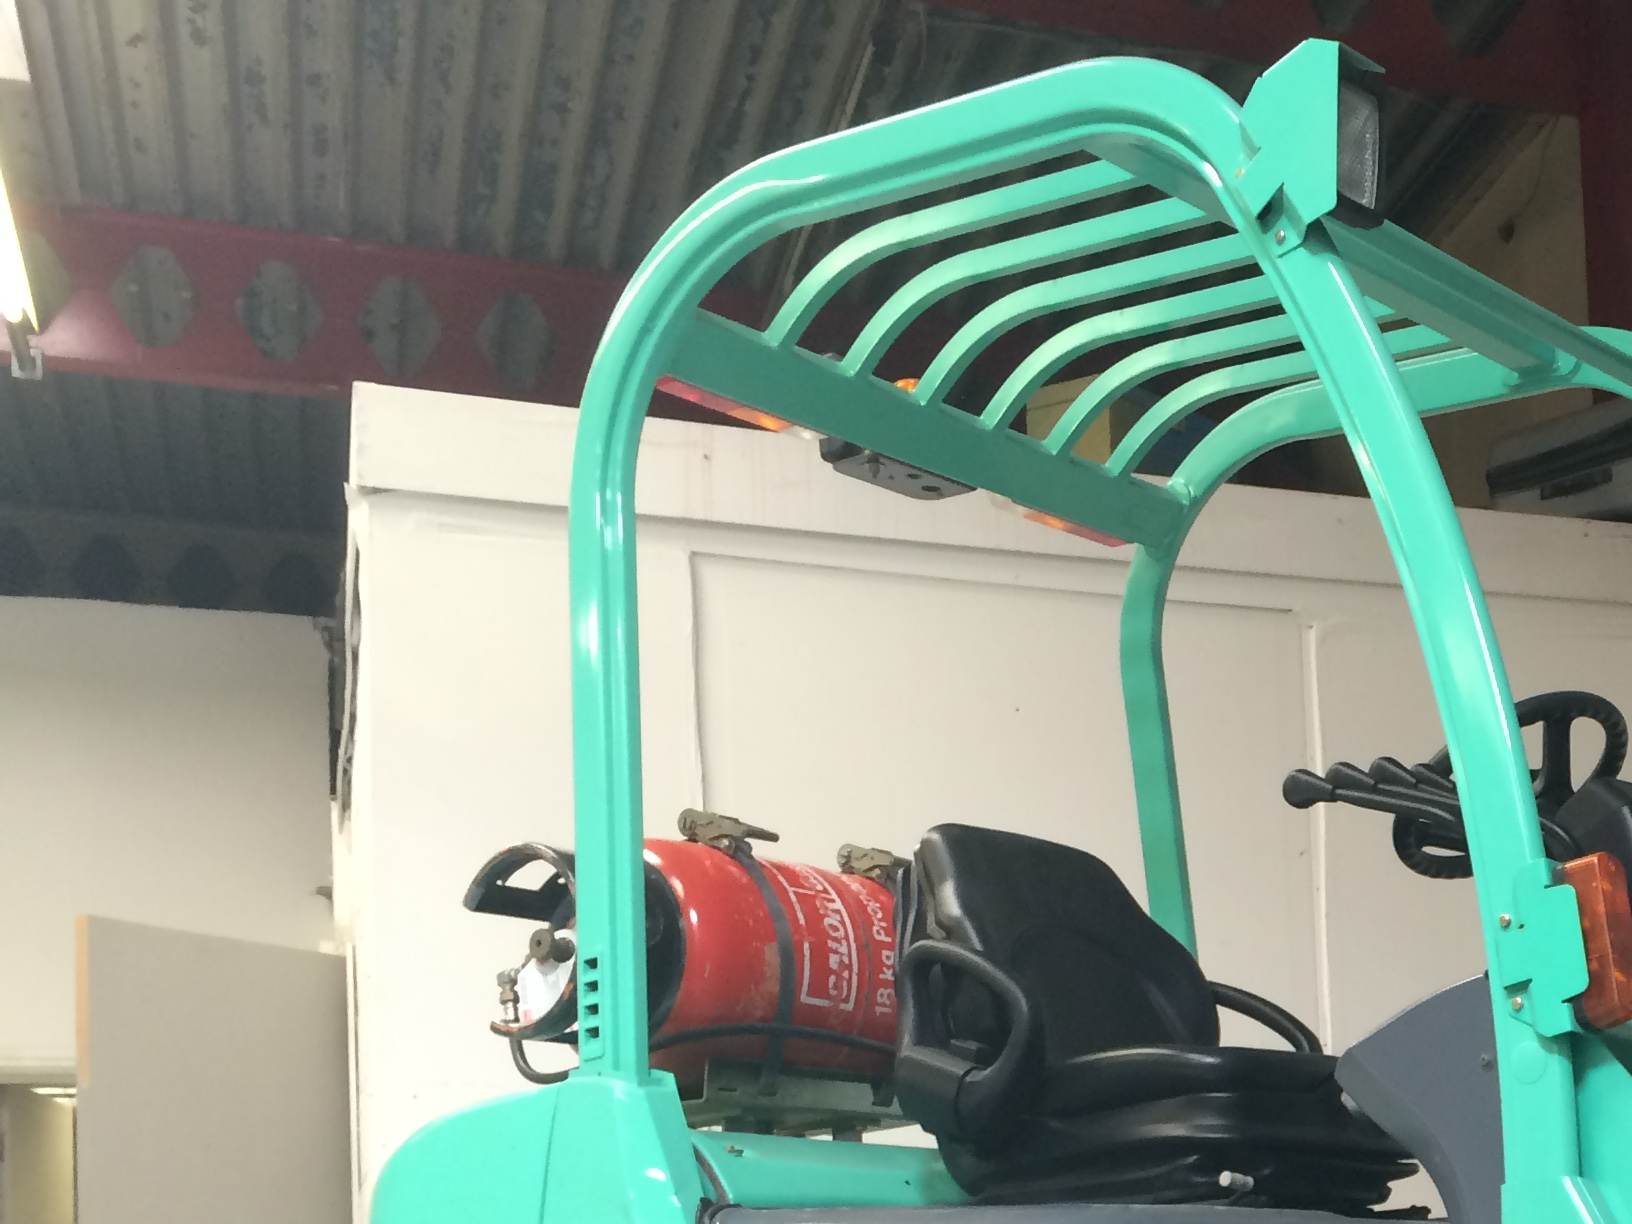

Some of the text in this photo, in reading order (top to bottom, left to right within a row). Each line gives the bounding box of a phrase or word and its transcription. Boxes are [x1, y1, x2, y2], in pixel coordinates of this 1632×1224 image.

[840, 872, 893, 943] Propa
[815, 894, 850, 999] CALOR
[874, 987, 896, 1016] 18
